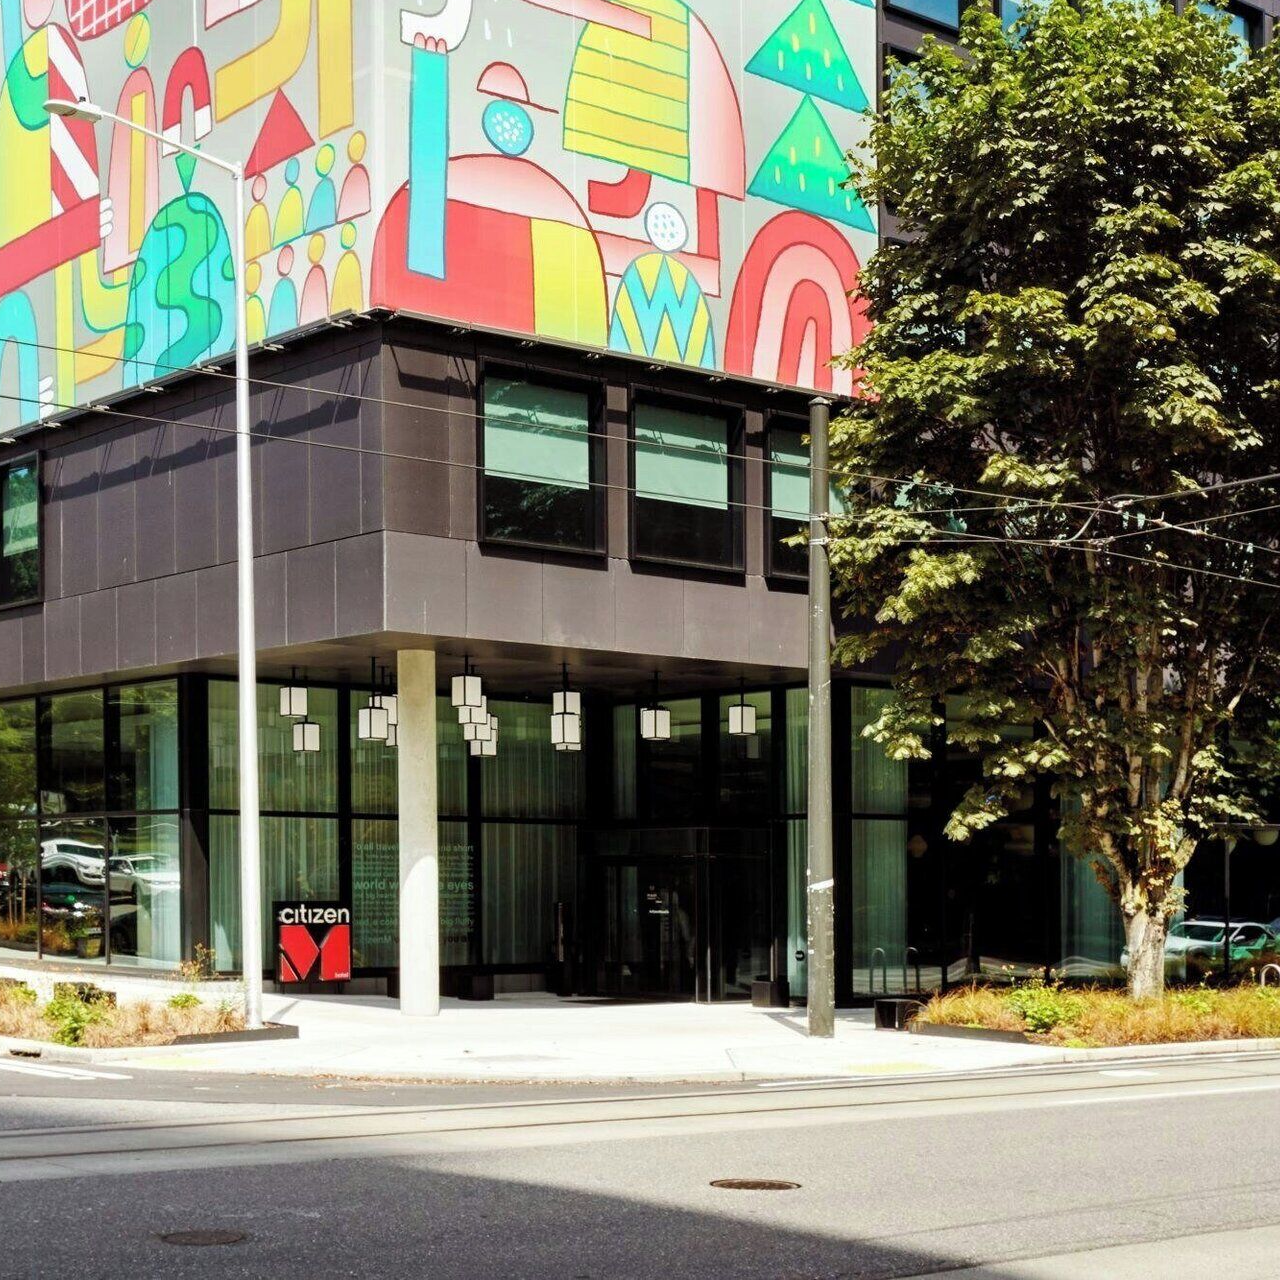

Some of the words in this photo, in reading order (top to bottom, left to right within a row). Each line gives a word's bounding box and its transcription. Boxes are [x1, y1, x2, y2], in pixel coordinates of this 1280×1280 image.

[353, 878, 386, 890] world
[447, 881, 474, 893] eyes
[280, 904, 350, 924] citizen
